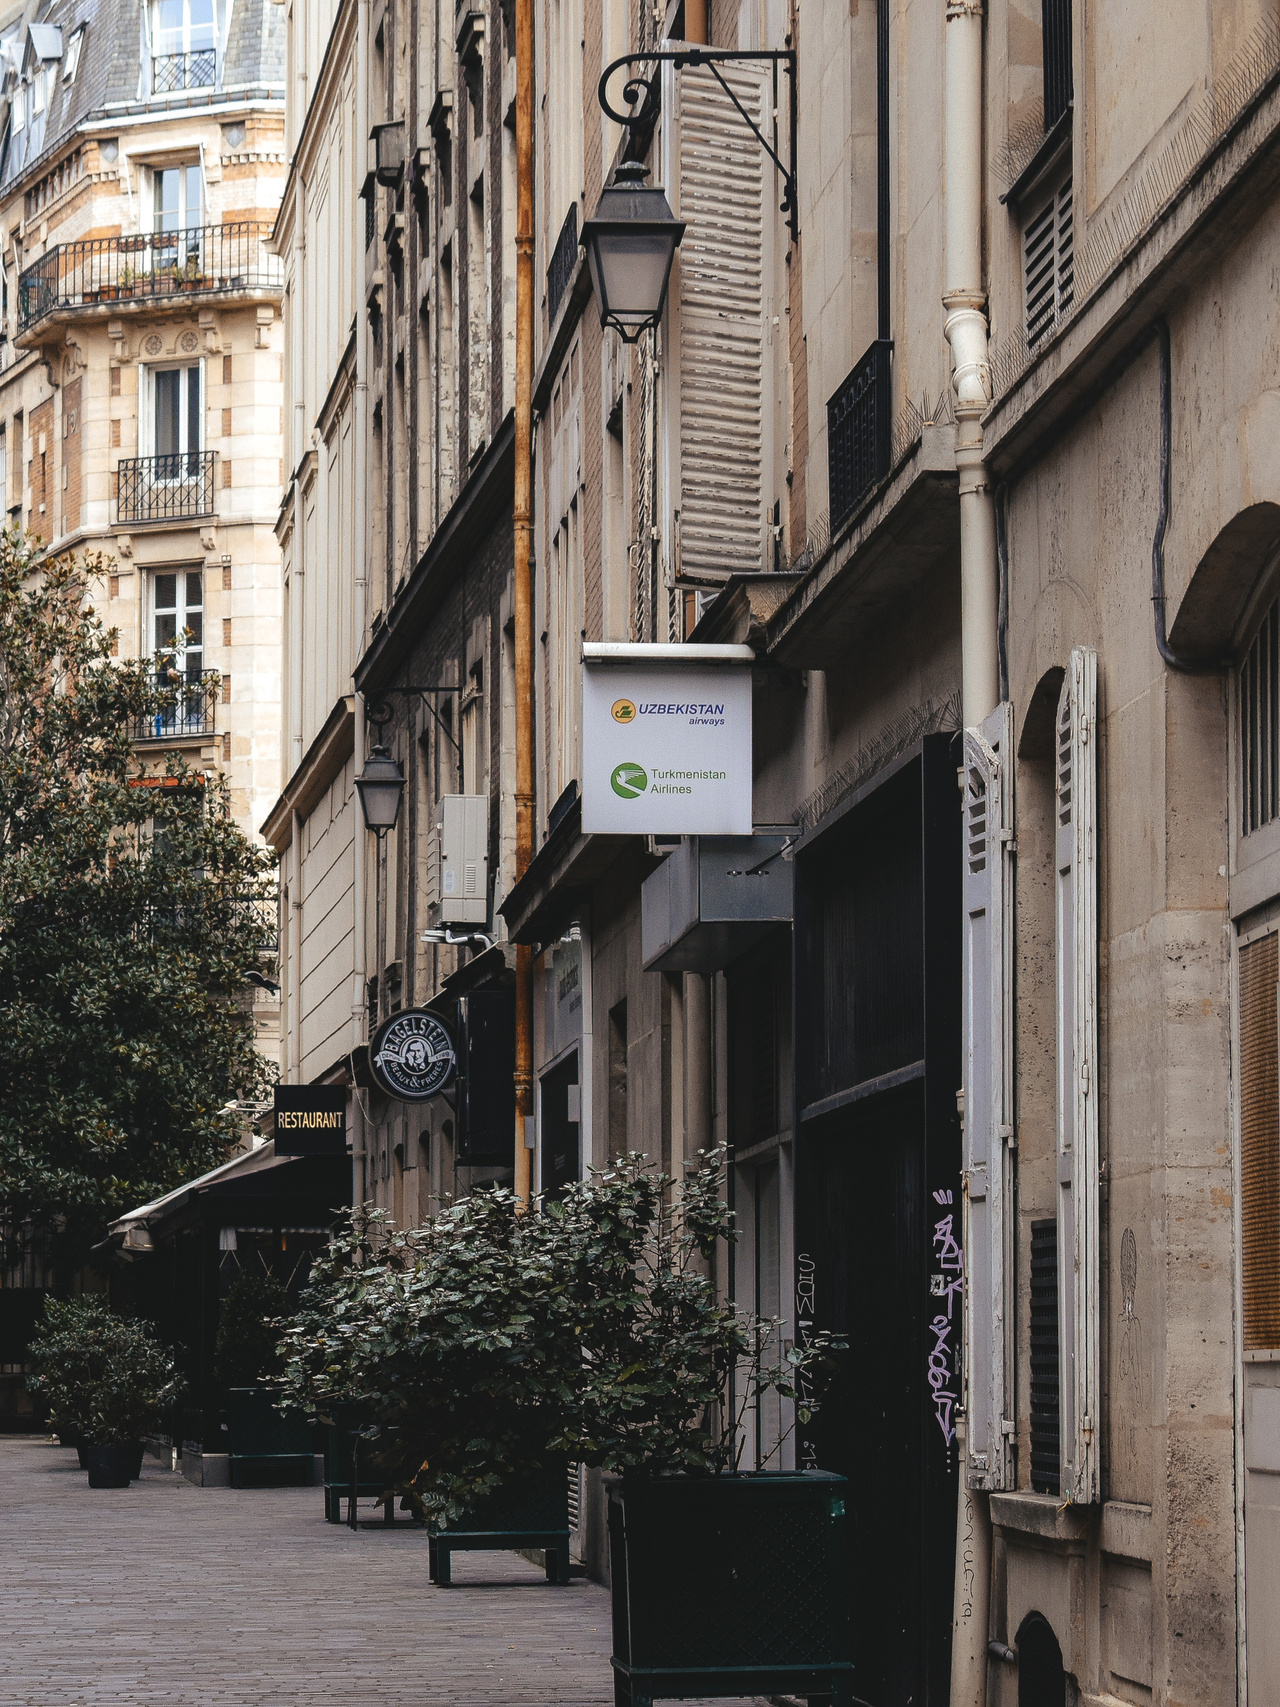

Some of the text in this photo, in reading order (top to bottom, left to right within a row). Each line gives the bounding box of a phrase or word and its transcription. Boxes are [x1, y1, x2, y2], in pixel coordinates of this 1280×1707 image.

[639, 704, 724, 714] UZBEKISTAN
[689, 717, 725, 726] airways
[651, 769, 726, 779] Turkmenistan
[650, 784, 692, 794] Airlines
[384, 1018, 449, 1052] BAGELSTEIN
[390, 1061, 411, 1086] BEAUX
[410, 1076, 421, 1089] &
[278, 1111, 343, 1129] RESTAURANT
